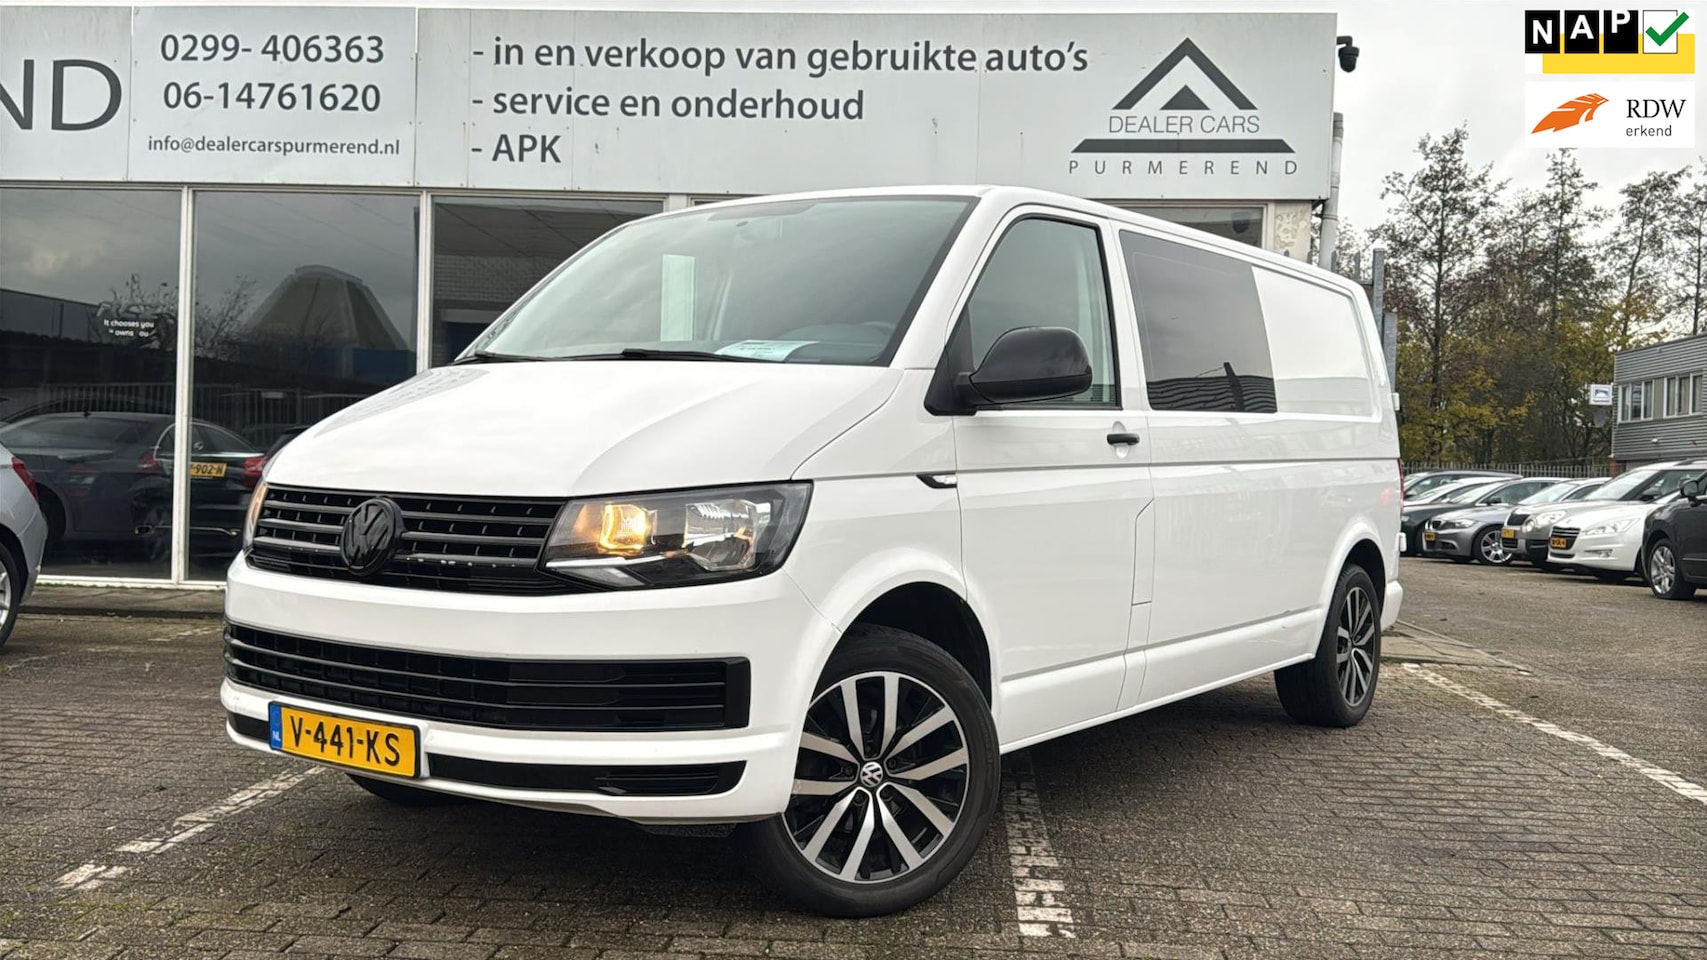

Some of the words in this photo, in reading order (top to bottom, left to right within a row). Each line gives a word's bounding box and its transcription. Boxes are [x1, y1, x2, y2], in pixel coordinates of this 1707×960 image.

[160, 33, 252, 62] 0299-
[261, 34, 384, 63] 406363
[494, 36, 524, 66] in
[534, 44, 575, 67] en
[584, 38, 726, 77] verkoop
[735, 47, 796, 70] van
[807, 40, 977, 79] gebruikte
[985, 41, 1088, 72] auto’s
[163, 81, 381, 112] 06-14761620
[493, 87, 610, 117] service
[619, 95, 660, 117] en
[671, 88, 864, 120] onderhoud
[1109, 115, 1193, 134] DEALER
[1200, 115, 1260, 134] CARS
[148, 135, 400, 157] info@dealercarspurmerend.nl
[491, 134, 561, 164] APK
[1069, 160, 1298, 175] PURMEREND
[290, 715, 400, 767] V-441-KS
